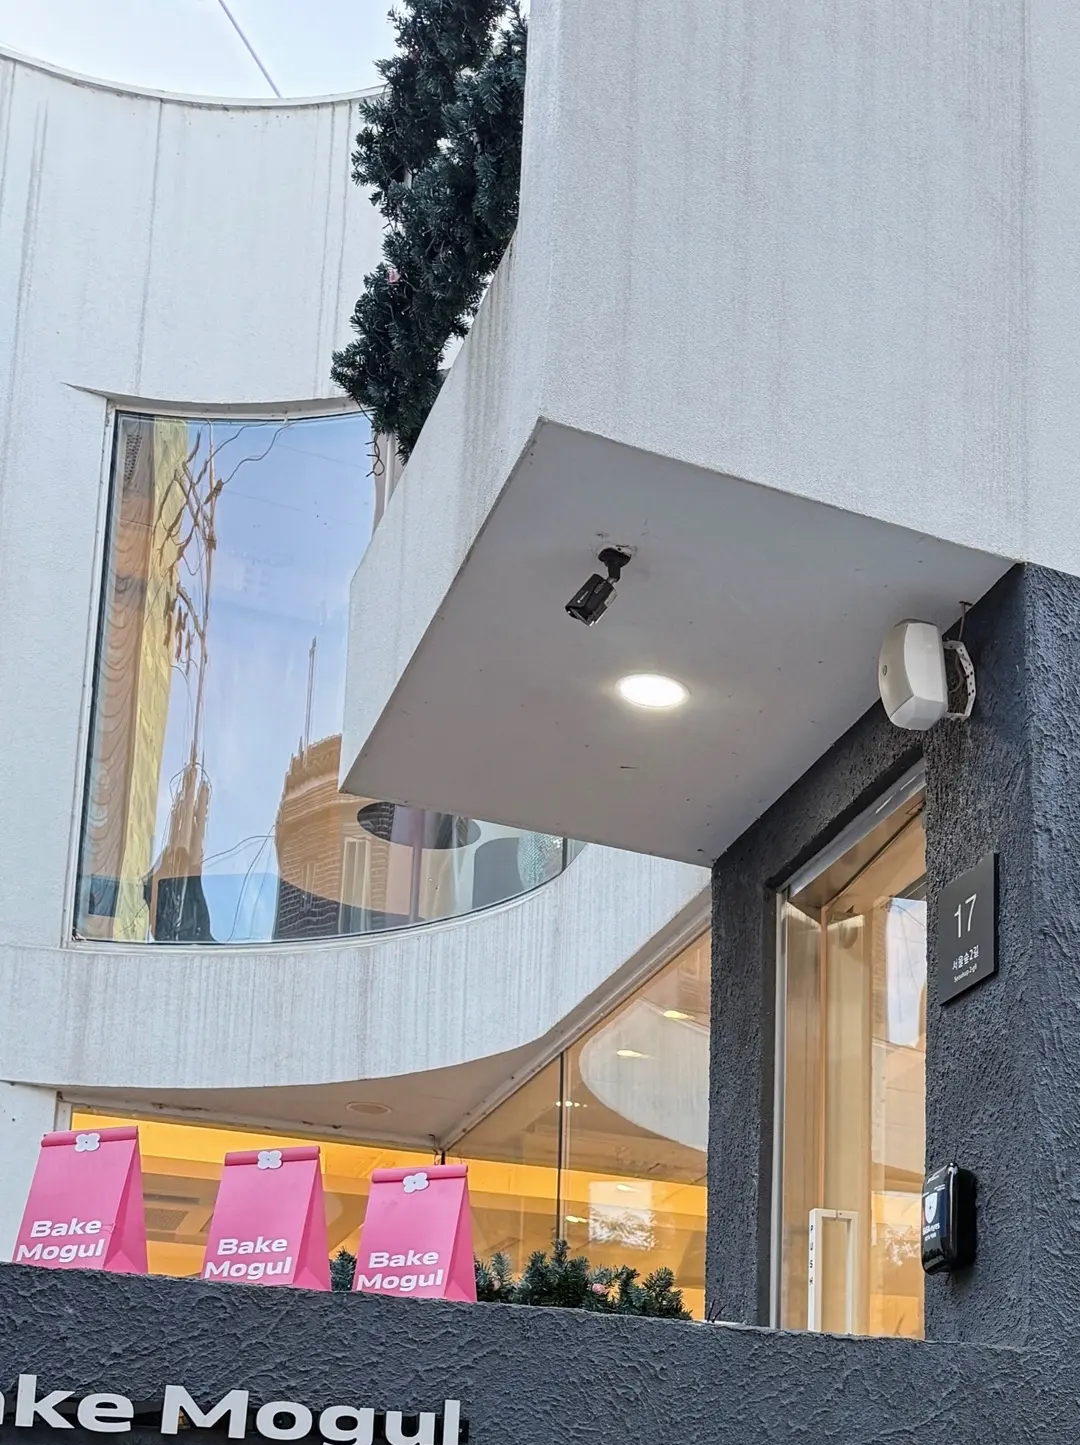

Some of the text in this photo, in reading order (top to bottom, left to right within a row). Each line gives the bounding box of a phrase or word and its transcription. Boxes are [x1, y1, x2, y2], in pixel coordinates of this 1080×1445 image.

[954, 893, 977, 938] 17
[30, 1218, 102, 1238] Bake
[16, 1239, 106, 1263] Mogul
[217, 1236, 288, 1255] Bake
[204, 1257, 293, 1280] Mogul
[368, 1249, 439, 1268] Bake
[356, 1269, 444, 1292] Mogul
[0, 1374, 134, 1433] ke
